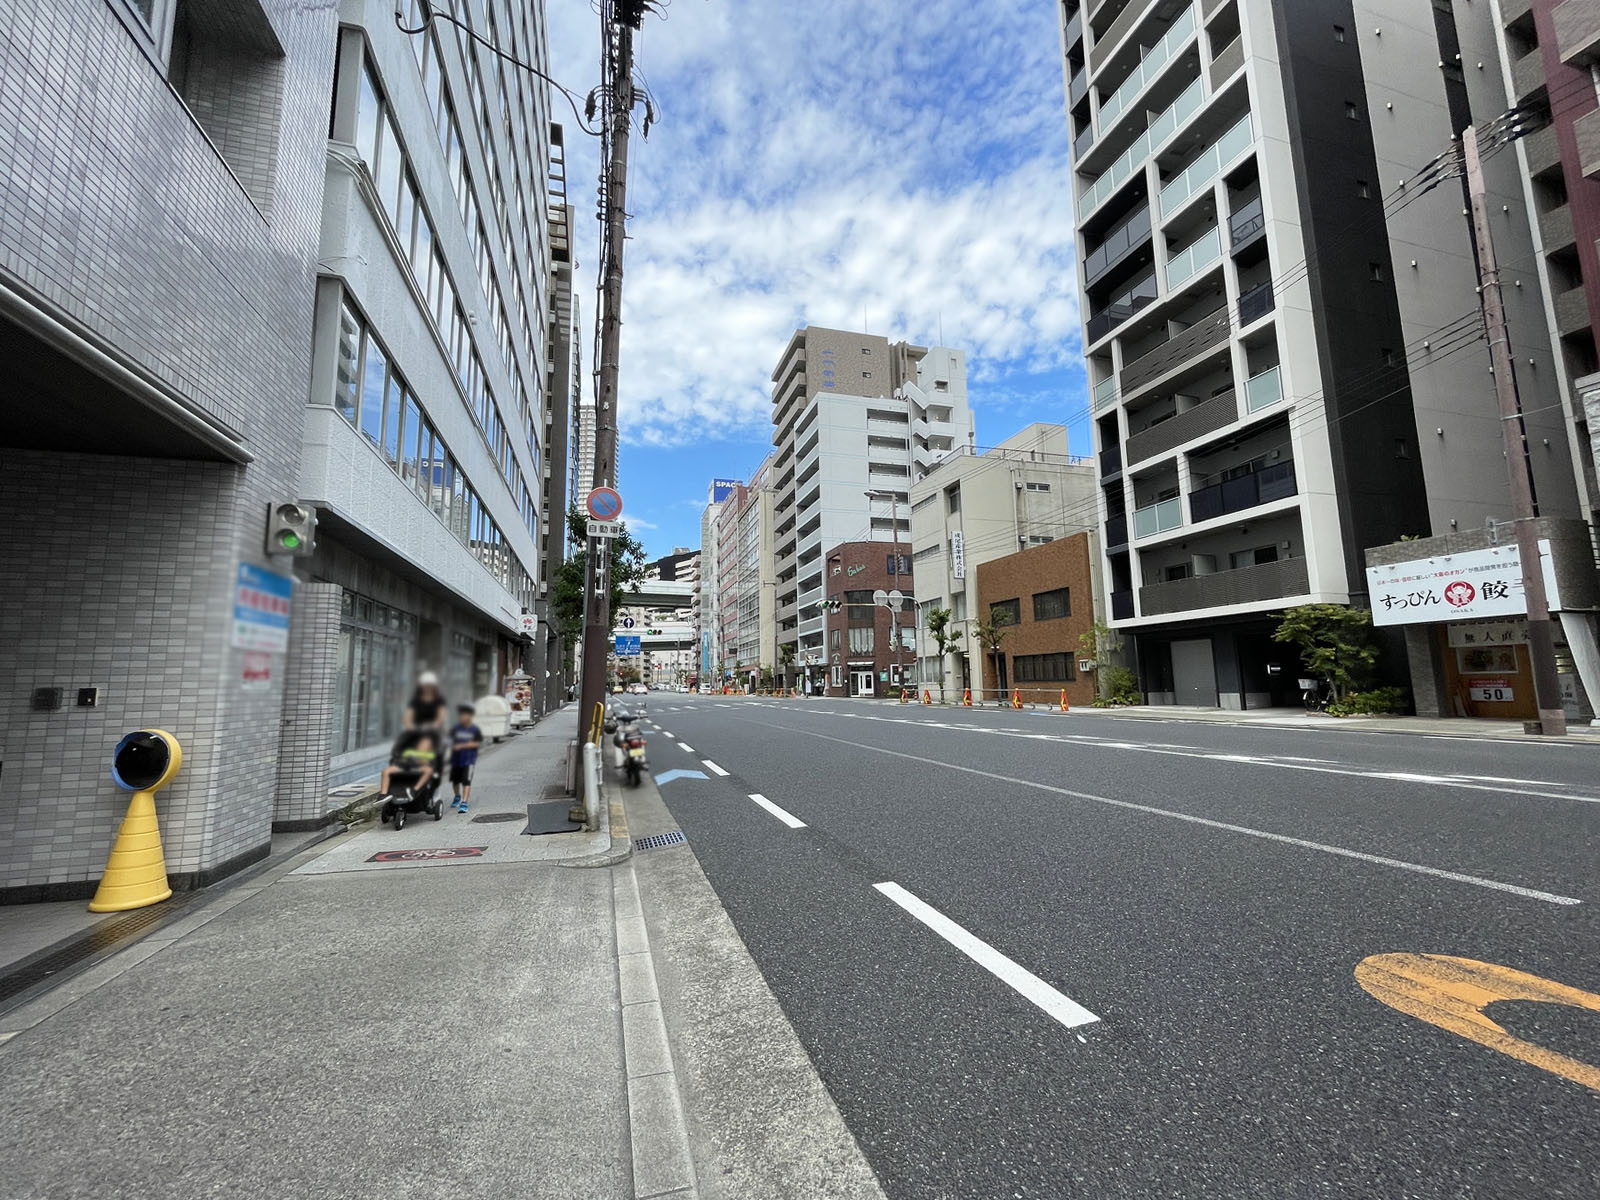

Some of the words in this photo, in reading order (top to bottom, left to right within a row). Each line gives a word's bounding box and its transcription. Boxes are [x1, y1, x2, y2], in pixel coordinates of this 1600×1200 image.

[715, 480, 738, 488] SPAC
[588, 524, 618, 534] 自動車
[1379, 589, 1441, 611] すっぴん
[1483, 689, 1503, 700] 50
